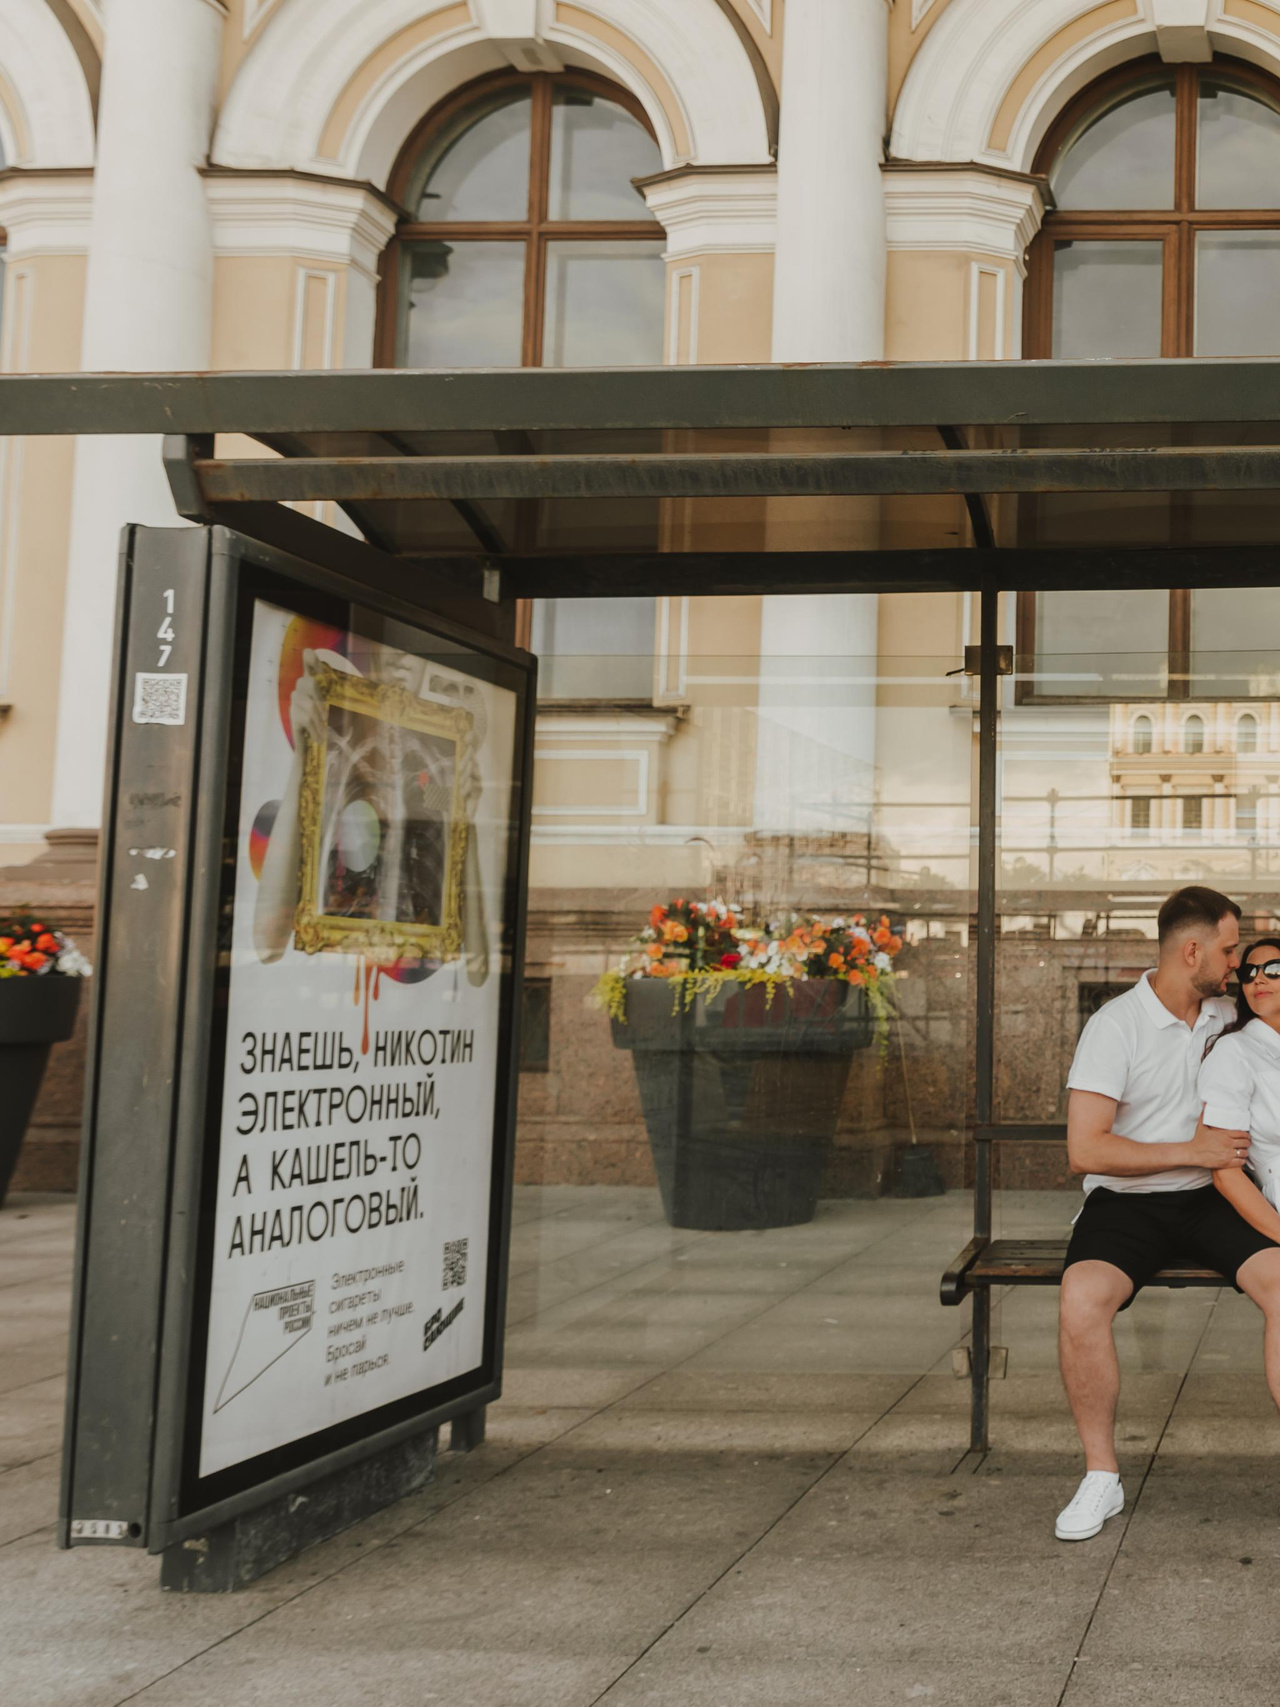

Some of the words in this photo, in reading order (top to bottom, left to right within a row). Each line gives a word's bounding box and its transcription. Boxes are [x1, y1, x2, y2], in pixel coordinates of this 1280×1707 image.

[156, 588, 177, 667] 147
[240, 1031, 360, 1075] ЗНАЕШЬ,
[373, 1029, 475, 1068] НИКОТИН
[236, 1072, 441, 1135] ЭЛЕКТРОННЫЙ,
[232, 1154, 252, 1197] А
[270, 1133, 422, 1191] КАШЕЛЬ-ТО
[228, 1176, 424, 1259] АНАЛОГОВЫЙ.
[331, 1260, 405, 1290] Электронные
[329, 1289, 382, 1314] сигареты
[327, 1317, 364, 1338] ничем
[366, 1312, 379, 1326] не
[326, 1335, 367, 1366] Бросай
[324, 1374, 333, 1387] и
[334, 1368, 349, 1383] не
